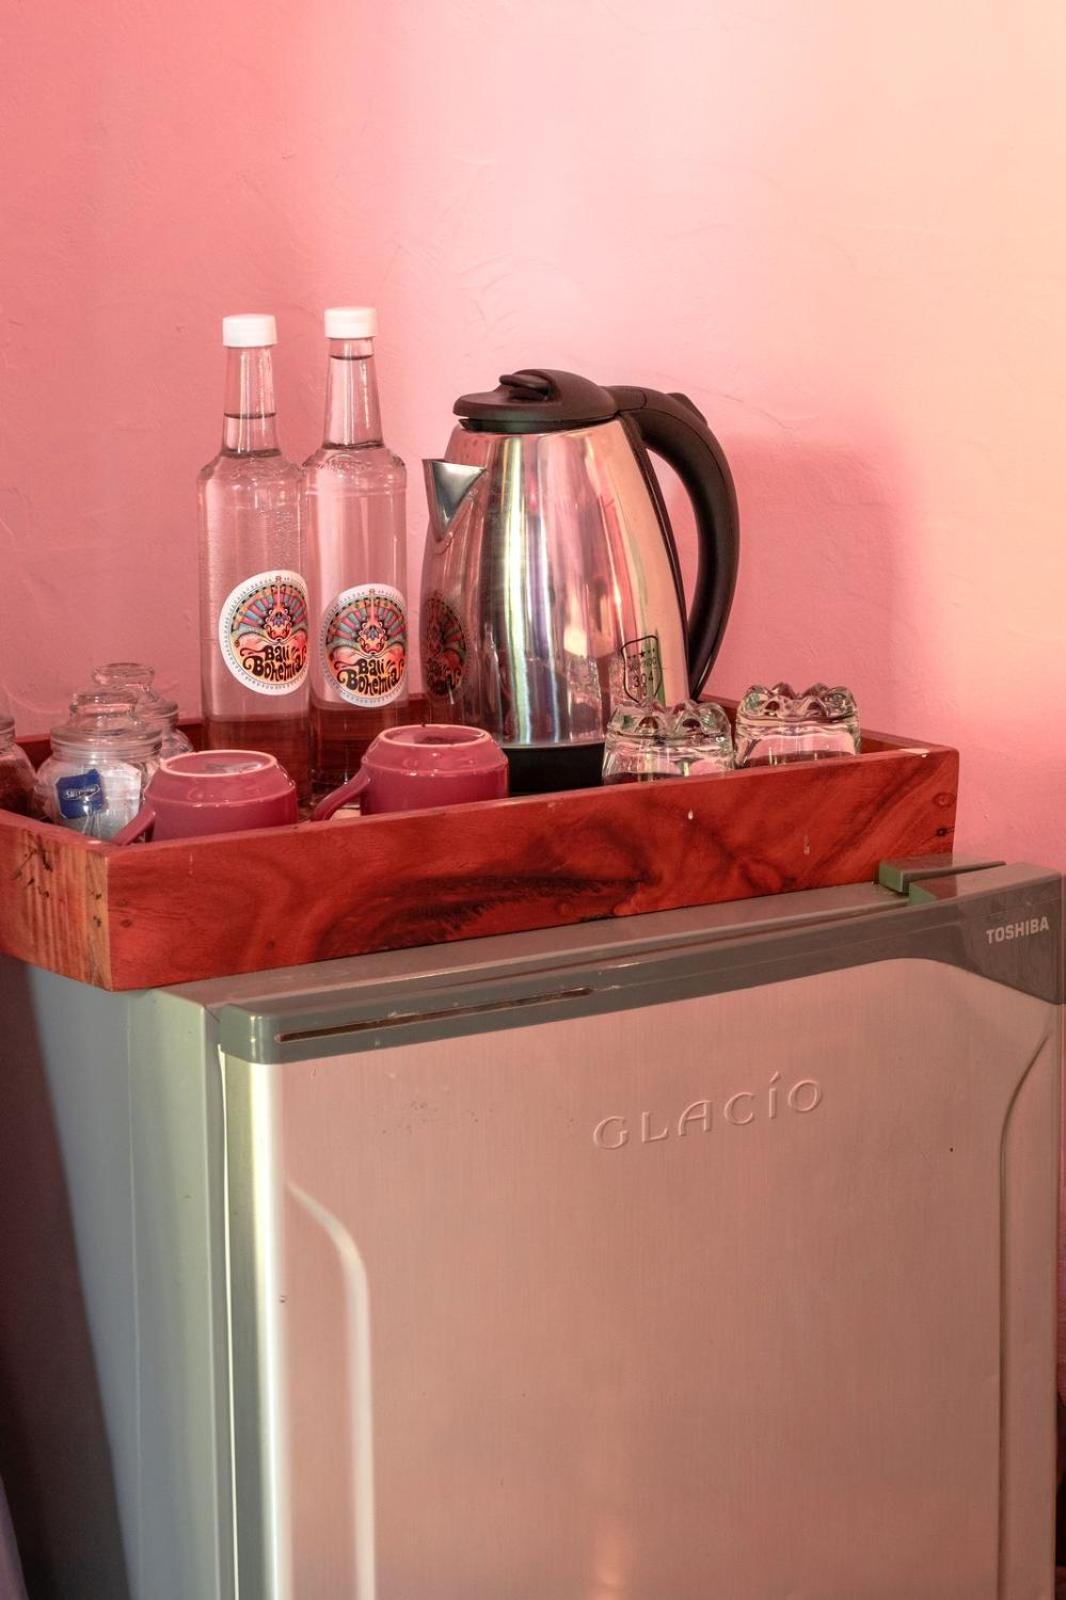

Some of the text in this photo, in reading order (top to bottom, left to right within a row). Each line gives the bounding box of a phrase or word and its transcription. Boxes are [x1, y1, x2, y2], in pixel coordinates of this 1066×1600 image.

[252, 645, 290, 662] Bali
[347, 658, 385, 676] Bali
[242, 654, 304, 682] Bohemia
[336, 668, 402, 696] Bohemia
[985, 916, 1049, 944] TOSHIBA
